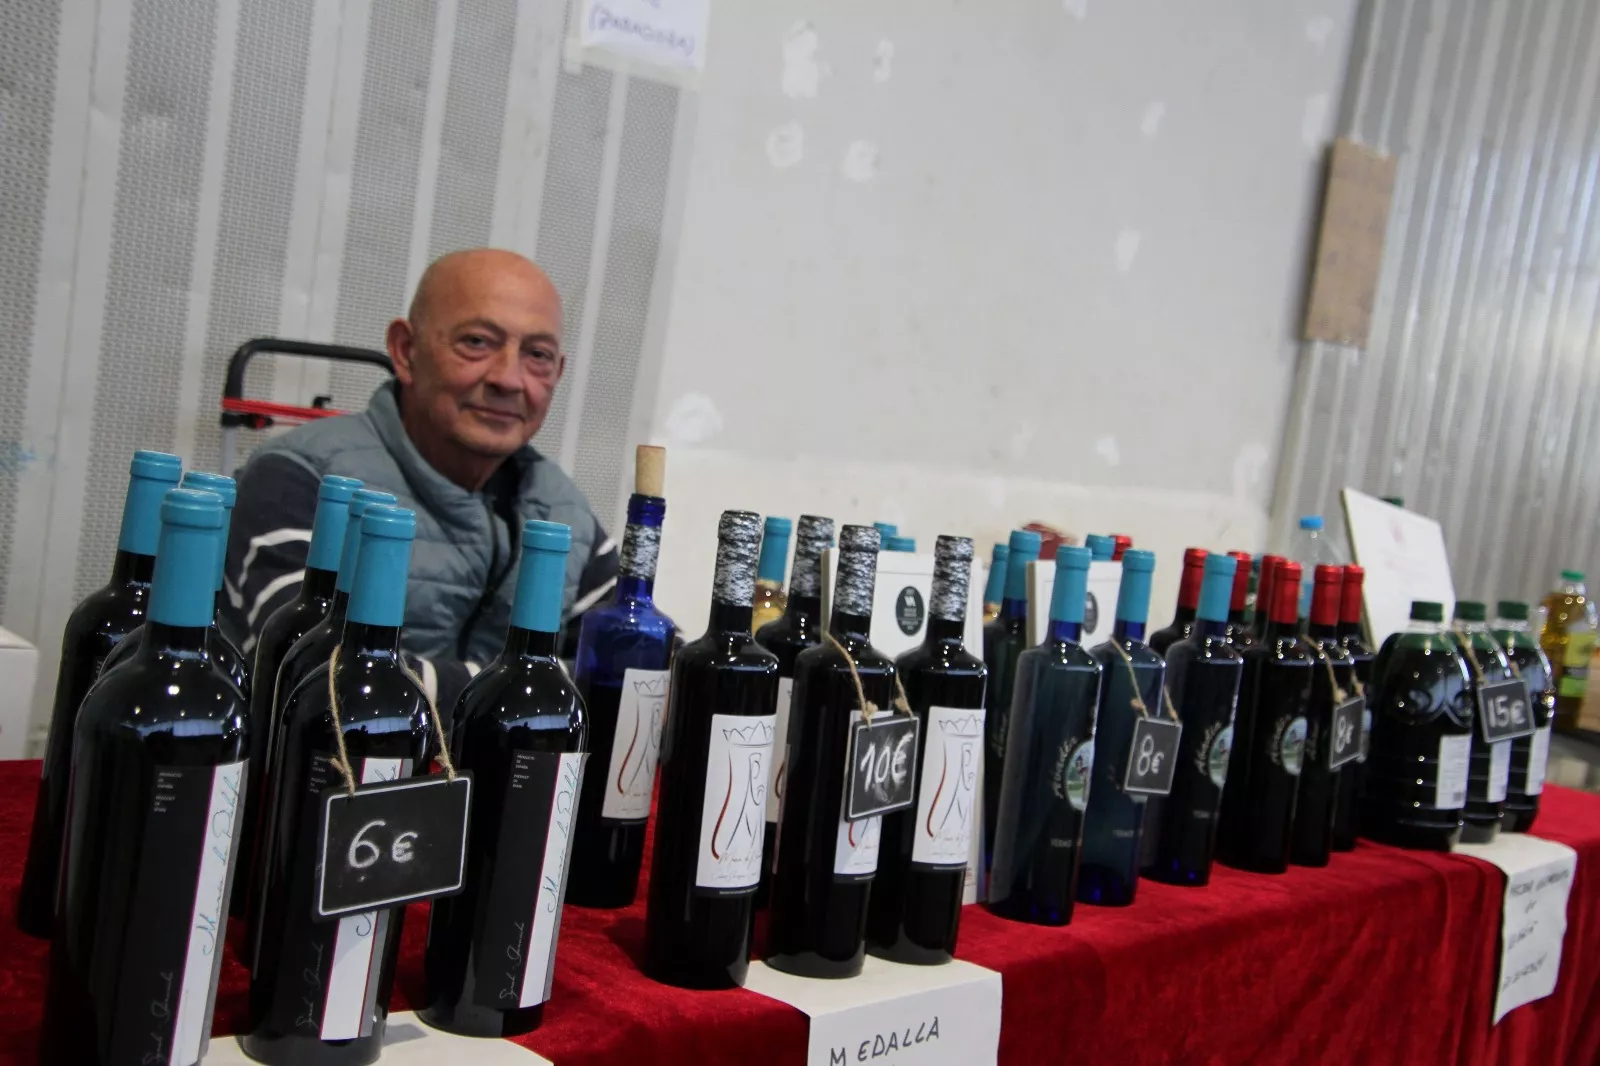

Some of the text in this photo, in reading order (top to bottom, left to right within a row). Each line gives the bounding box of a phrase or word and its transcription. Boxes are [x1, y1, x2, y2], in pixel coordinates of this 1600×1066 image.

[1486, 694, 1526, 728] 15€
[860, 731, 914, 793] 10€
[1136, 734, 1165, 777] 8€
